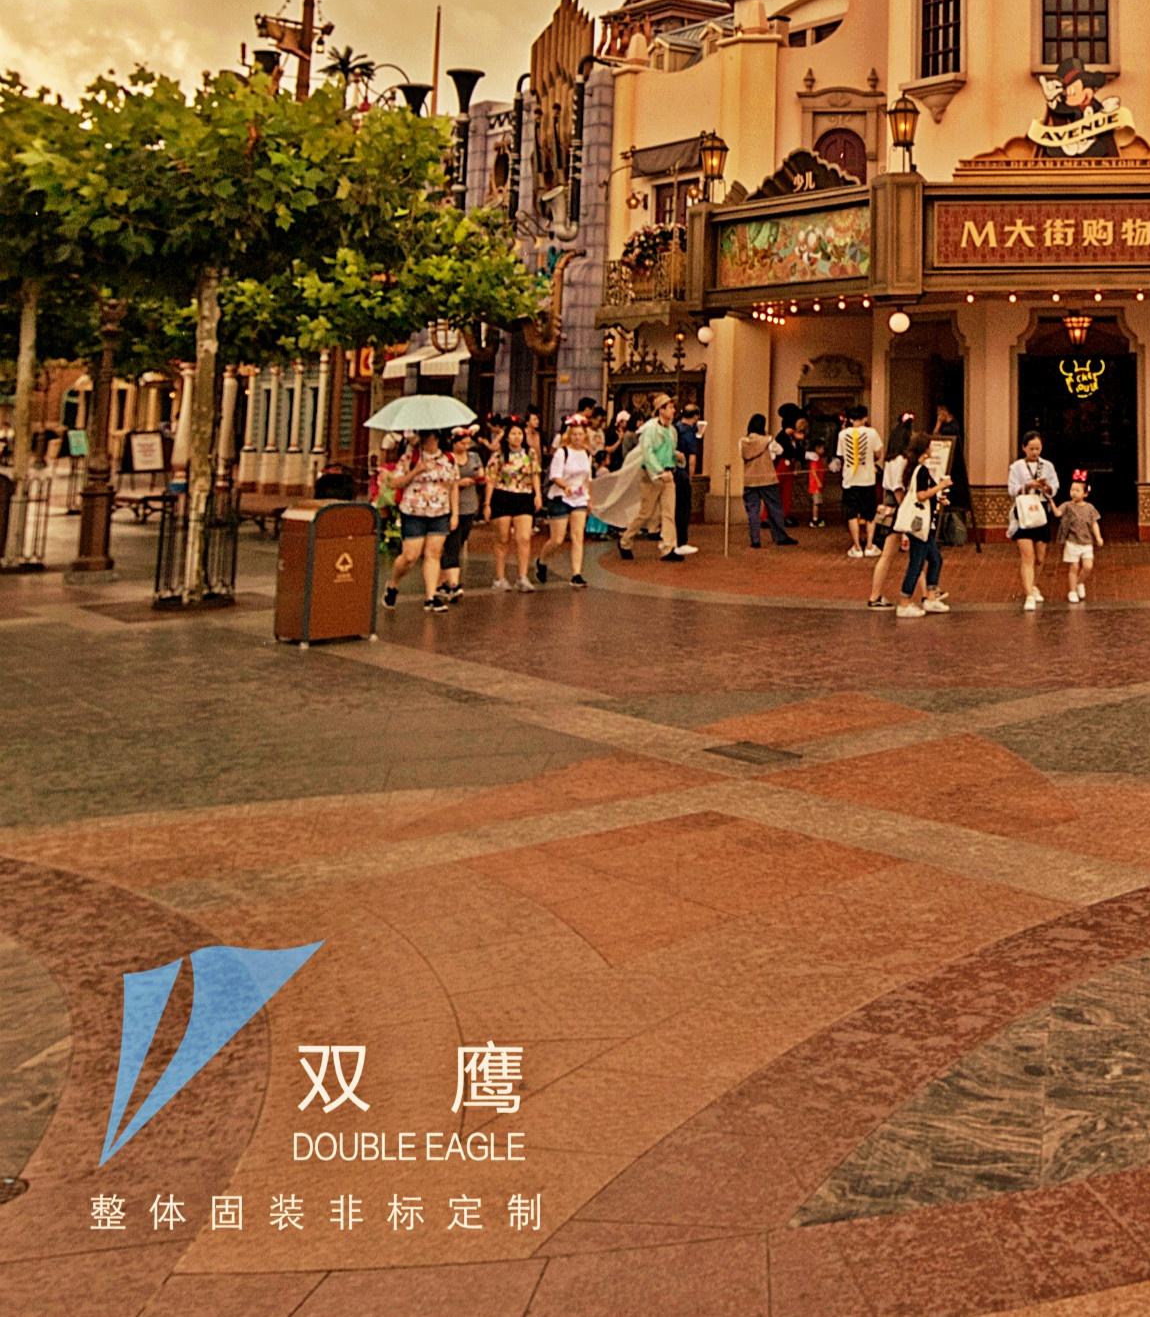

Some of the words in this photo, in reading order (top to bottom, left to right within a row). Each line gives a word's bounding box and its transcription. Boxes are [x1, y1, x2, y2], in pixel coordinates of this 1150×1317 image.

[1040, 113, 1119, 141] AVENUE
[1102, 159, 1141, 168] STORE
[792, 169, 816, 193] 少儿
